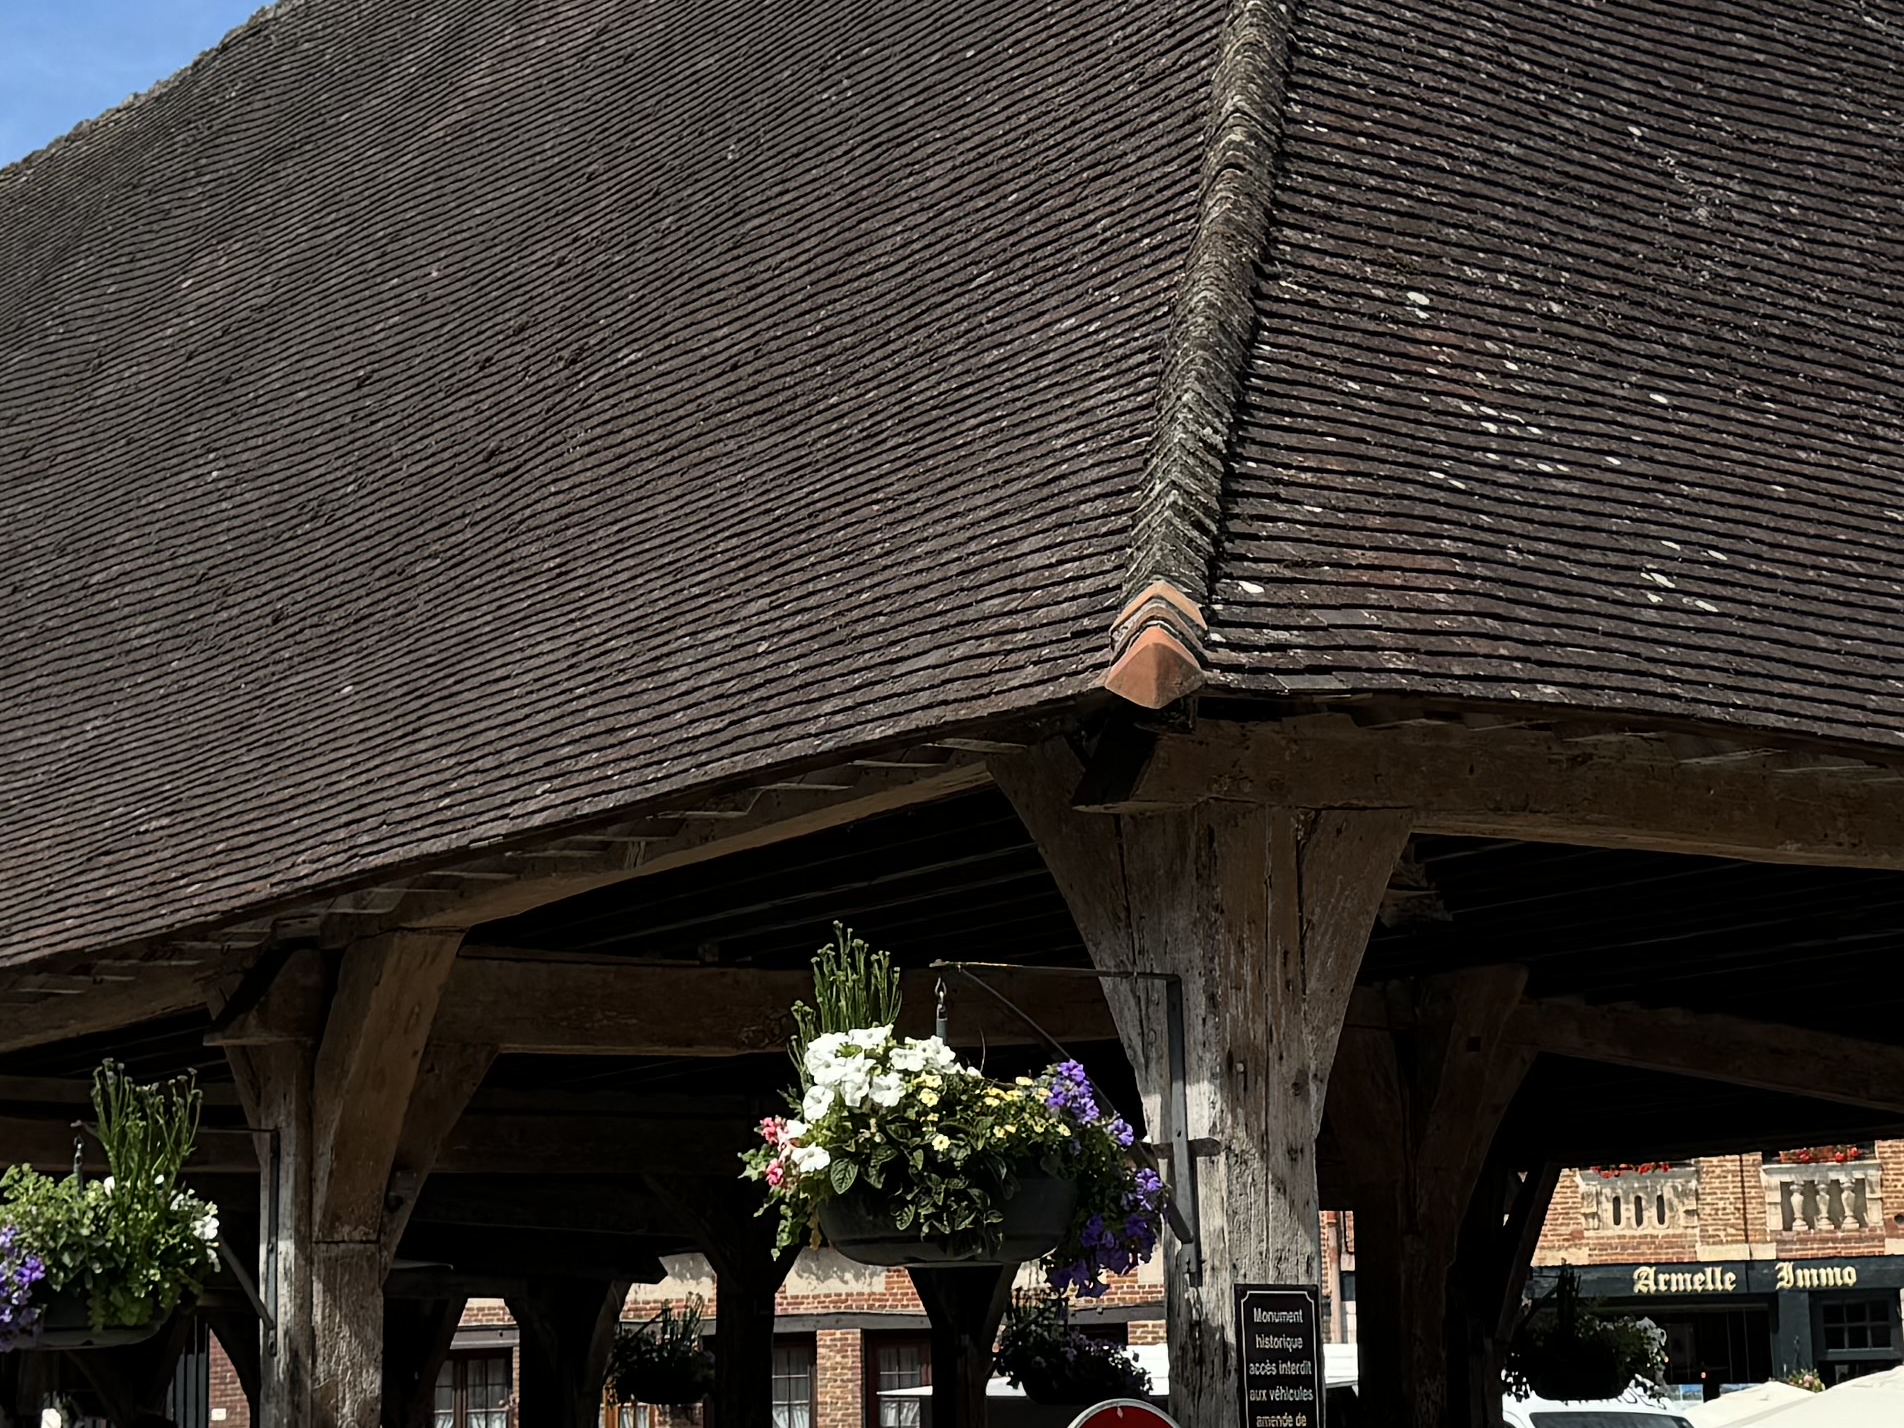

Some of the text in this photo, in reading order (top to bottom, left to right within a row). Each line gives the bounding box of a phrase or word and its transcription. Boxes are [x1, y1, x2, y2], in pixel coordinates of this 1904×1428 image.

[1632, 1261, 1858, 1295] Armelle Immo
[1253, 1307, 1303, 1323] Monument
[1255, 1334, 1303, 1353] historique
[1248, 1360, 1312, 1375] accès interdit
[1249, 1385, 1314, 1401] aux véhicules
[1256, 1412, 1307, 1428] amende de
